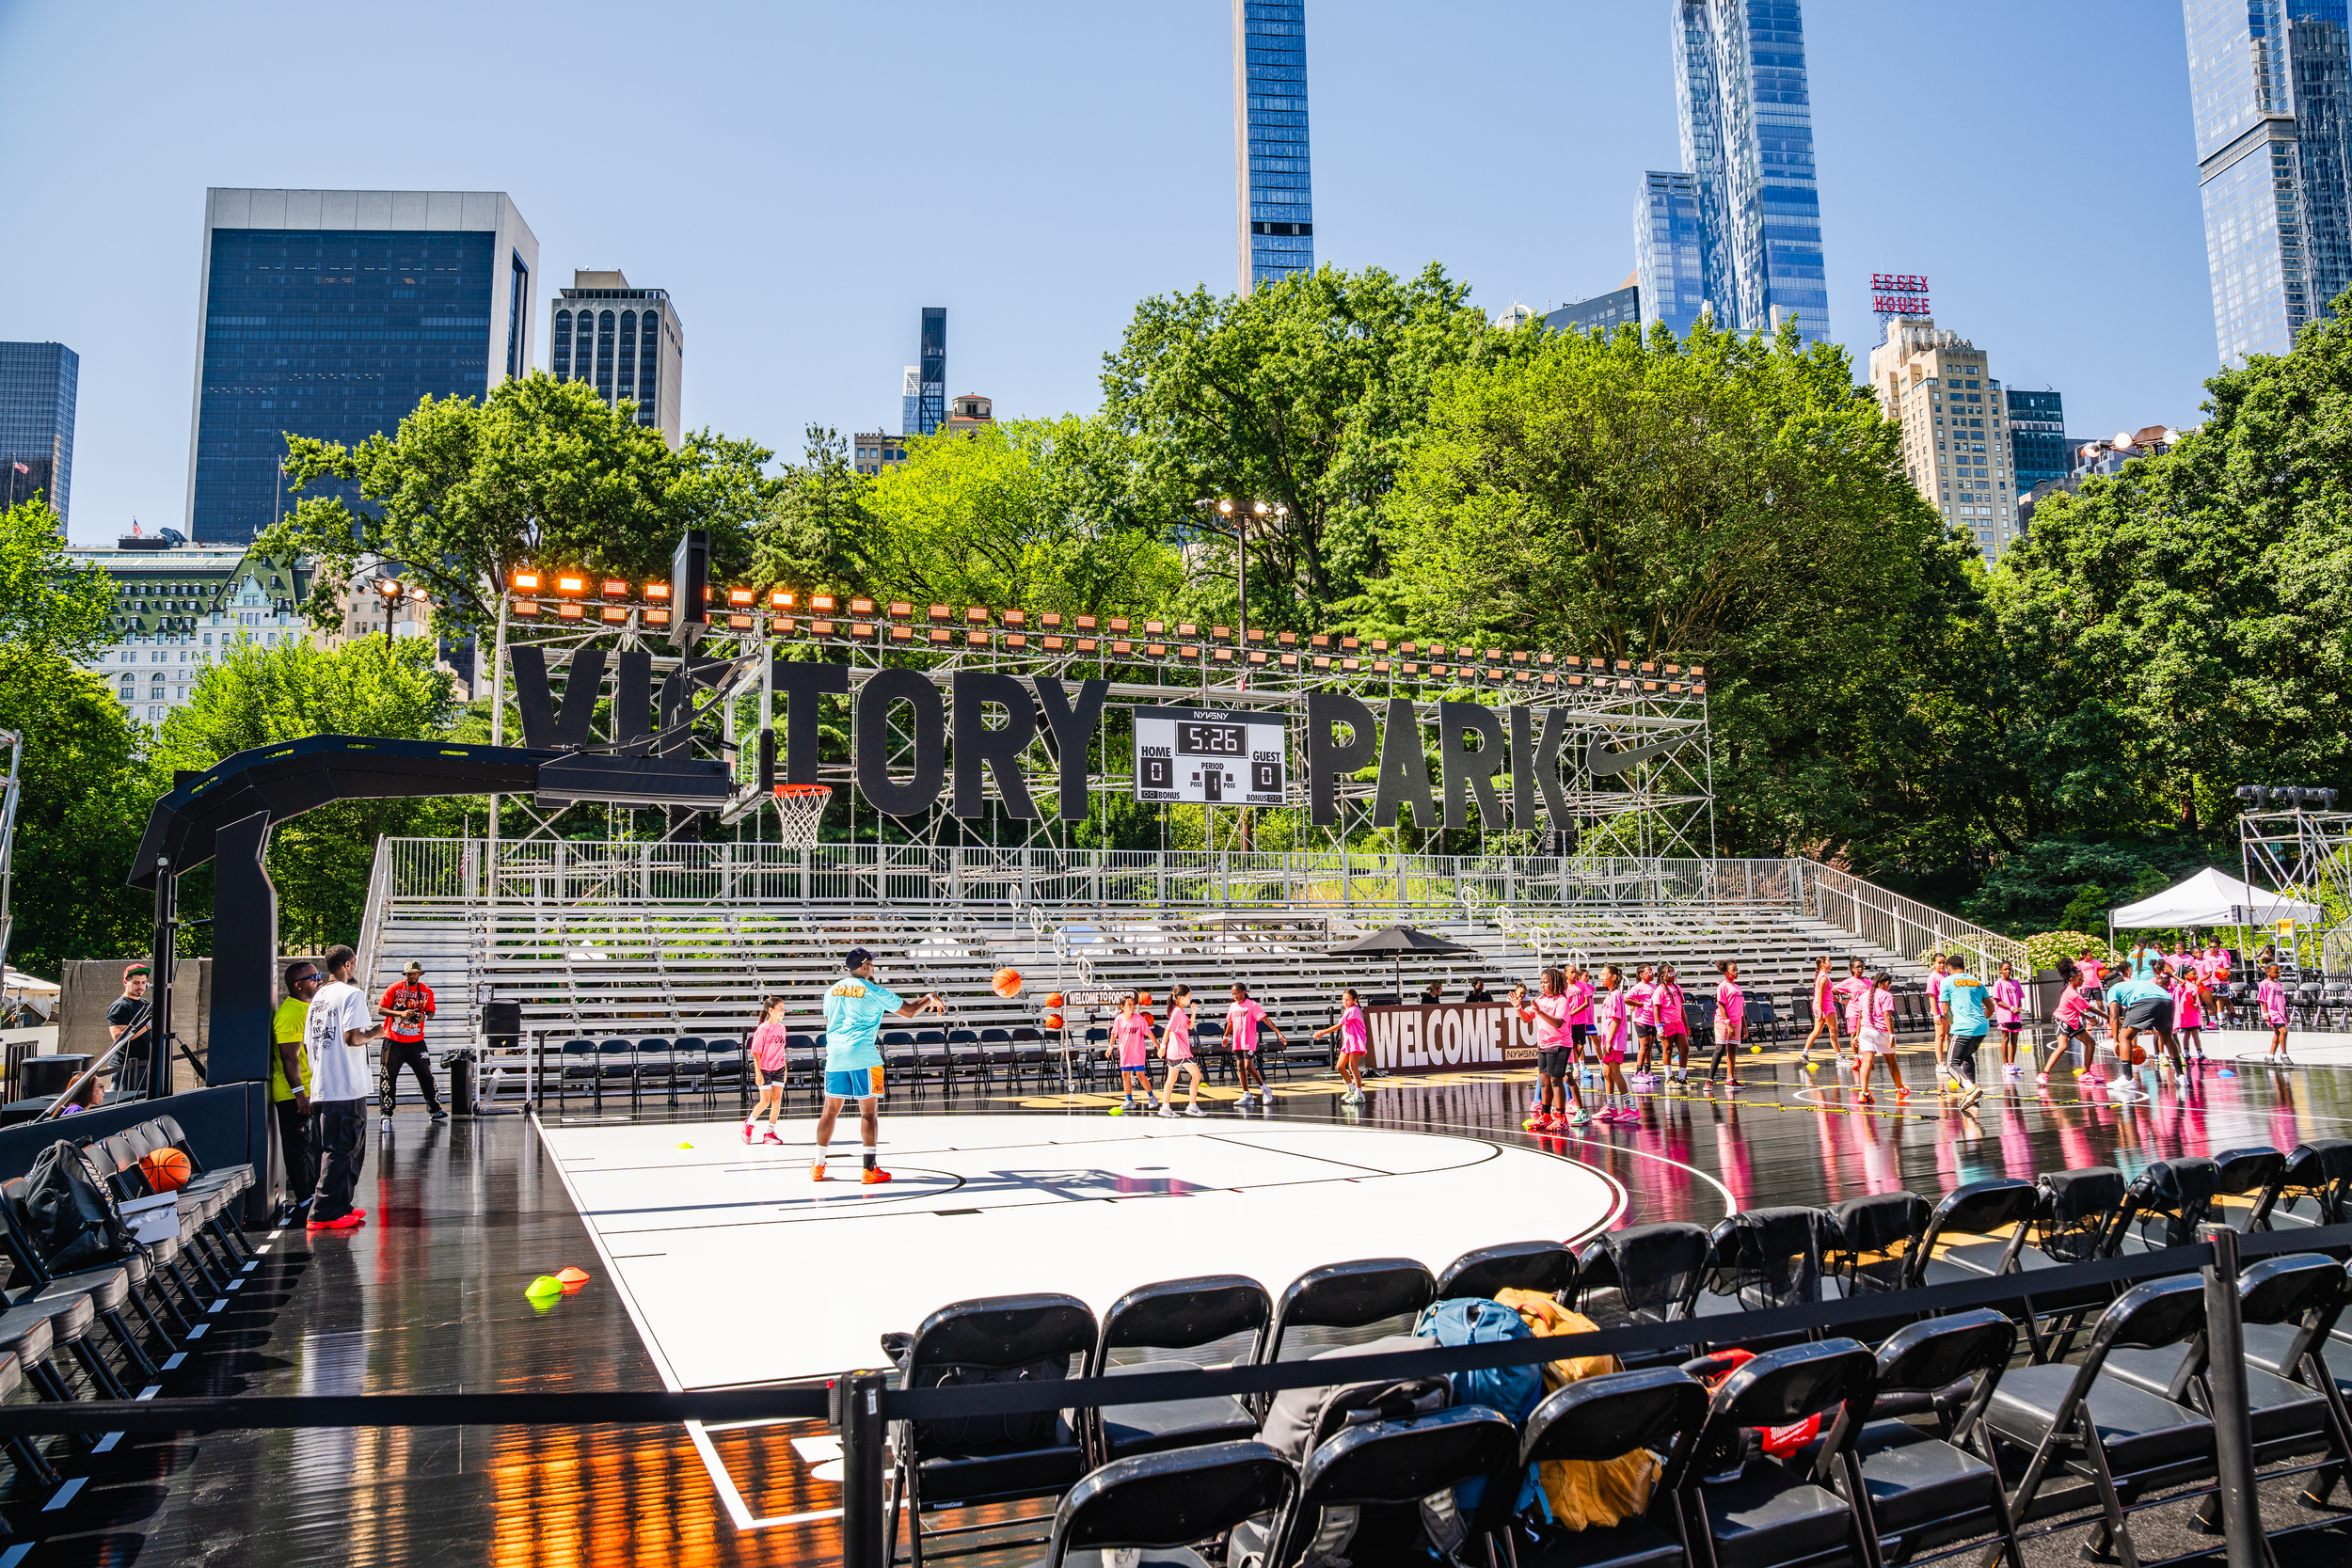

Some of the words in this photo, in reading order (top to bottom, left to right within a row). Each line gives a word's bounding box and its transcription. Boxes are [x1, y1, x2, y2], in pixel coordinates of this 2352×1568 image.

[1872, 274, 1929, 292] ESSEX
[1874, 295, 1931, 313] HOUSE
[1189, 727, 1238, 752] 5:26
[1141, 746, 1171, 757] HOME
[1253, 751, 1280, 762] GUEST
[1200, 762, 1224, 770] PERIOD
[1308, 693, 1574, 832] PARK
[1151, 762, 1163, 782] 0
[1261, 767, 1273, 785] 0
[1158, 791, 1180, 800] BONUS
[832, 985, 866, 999] COACH
[1069, 991, 1099, 1006] WELCOME
[1099, 991, 1108, 1001] TO
[1369, 1008, 1503, 1069] WELCOME
[1504, 1007, 1538, 1046] TO
